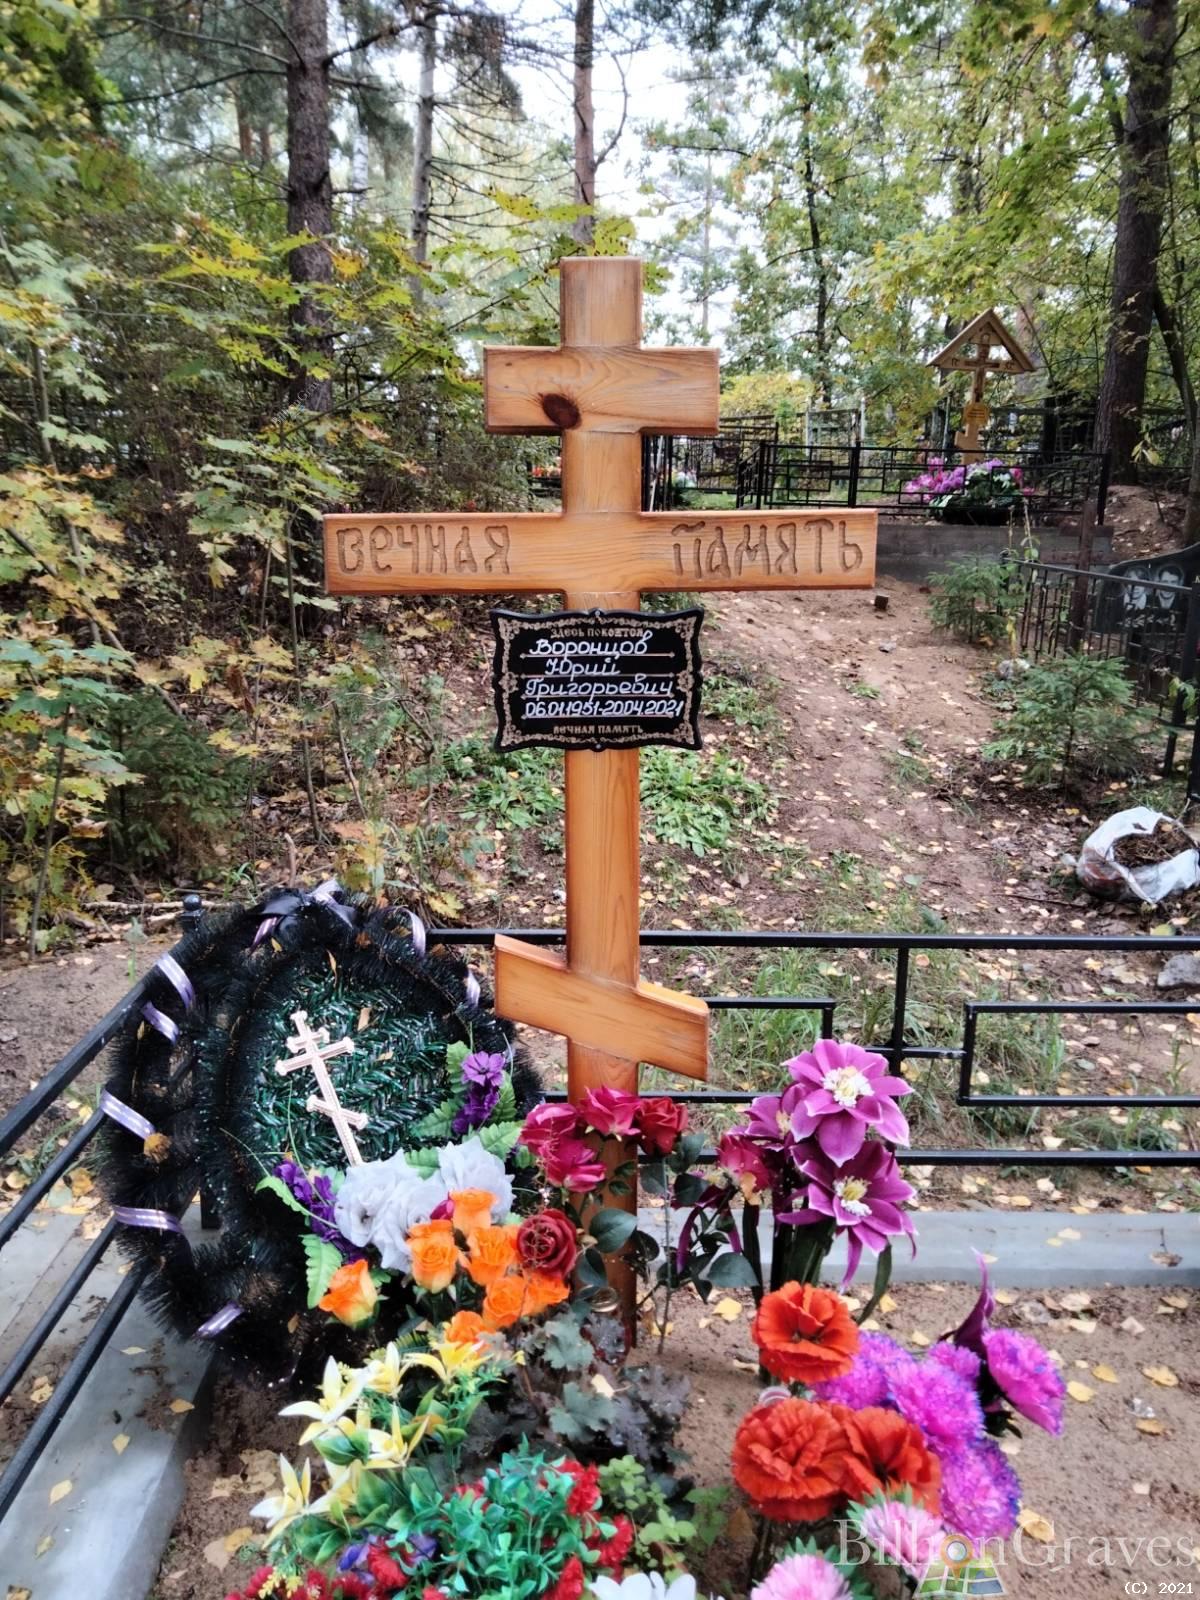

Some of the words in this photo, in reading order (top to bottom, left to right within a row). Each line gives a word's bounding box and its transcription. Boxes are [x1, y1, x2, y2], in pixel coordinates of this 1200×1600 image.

[671, 518, 864, 579] ПАМЯТЬ
[529, 630, 654, 661] Воронцов
[550, 627, 585, 639] ЗДЕСЬ
[545, 657, 621, 682] Юрий
[525, 673, 674, 702] Григорьевич
[598, 724, 643, 734] ПАМЯТЬ
